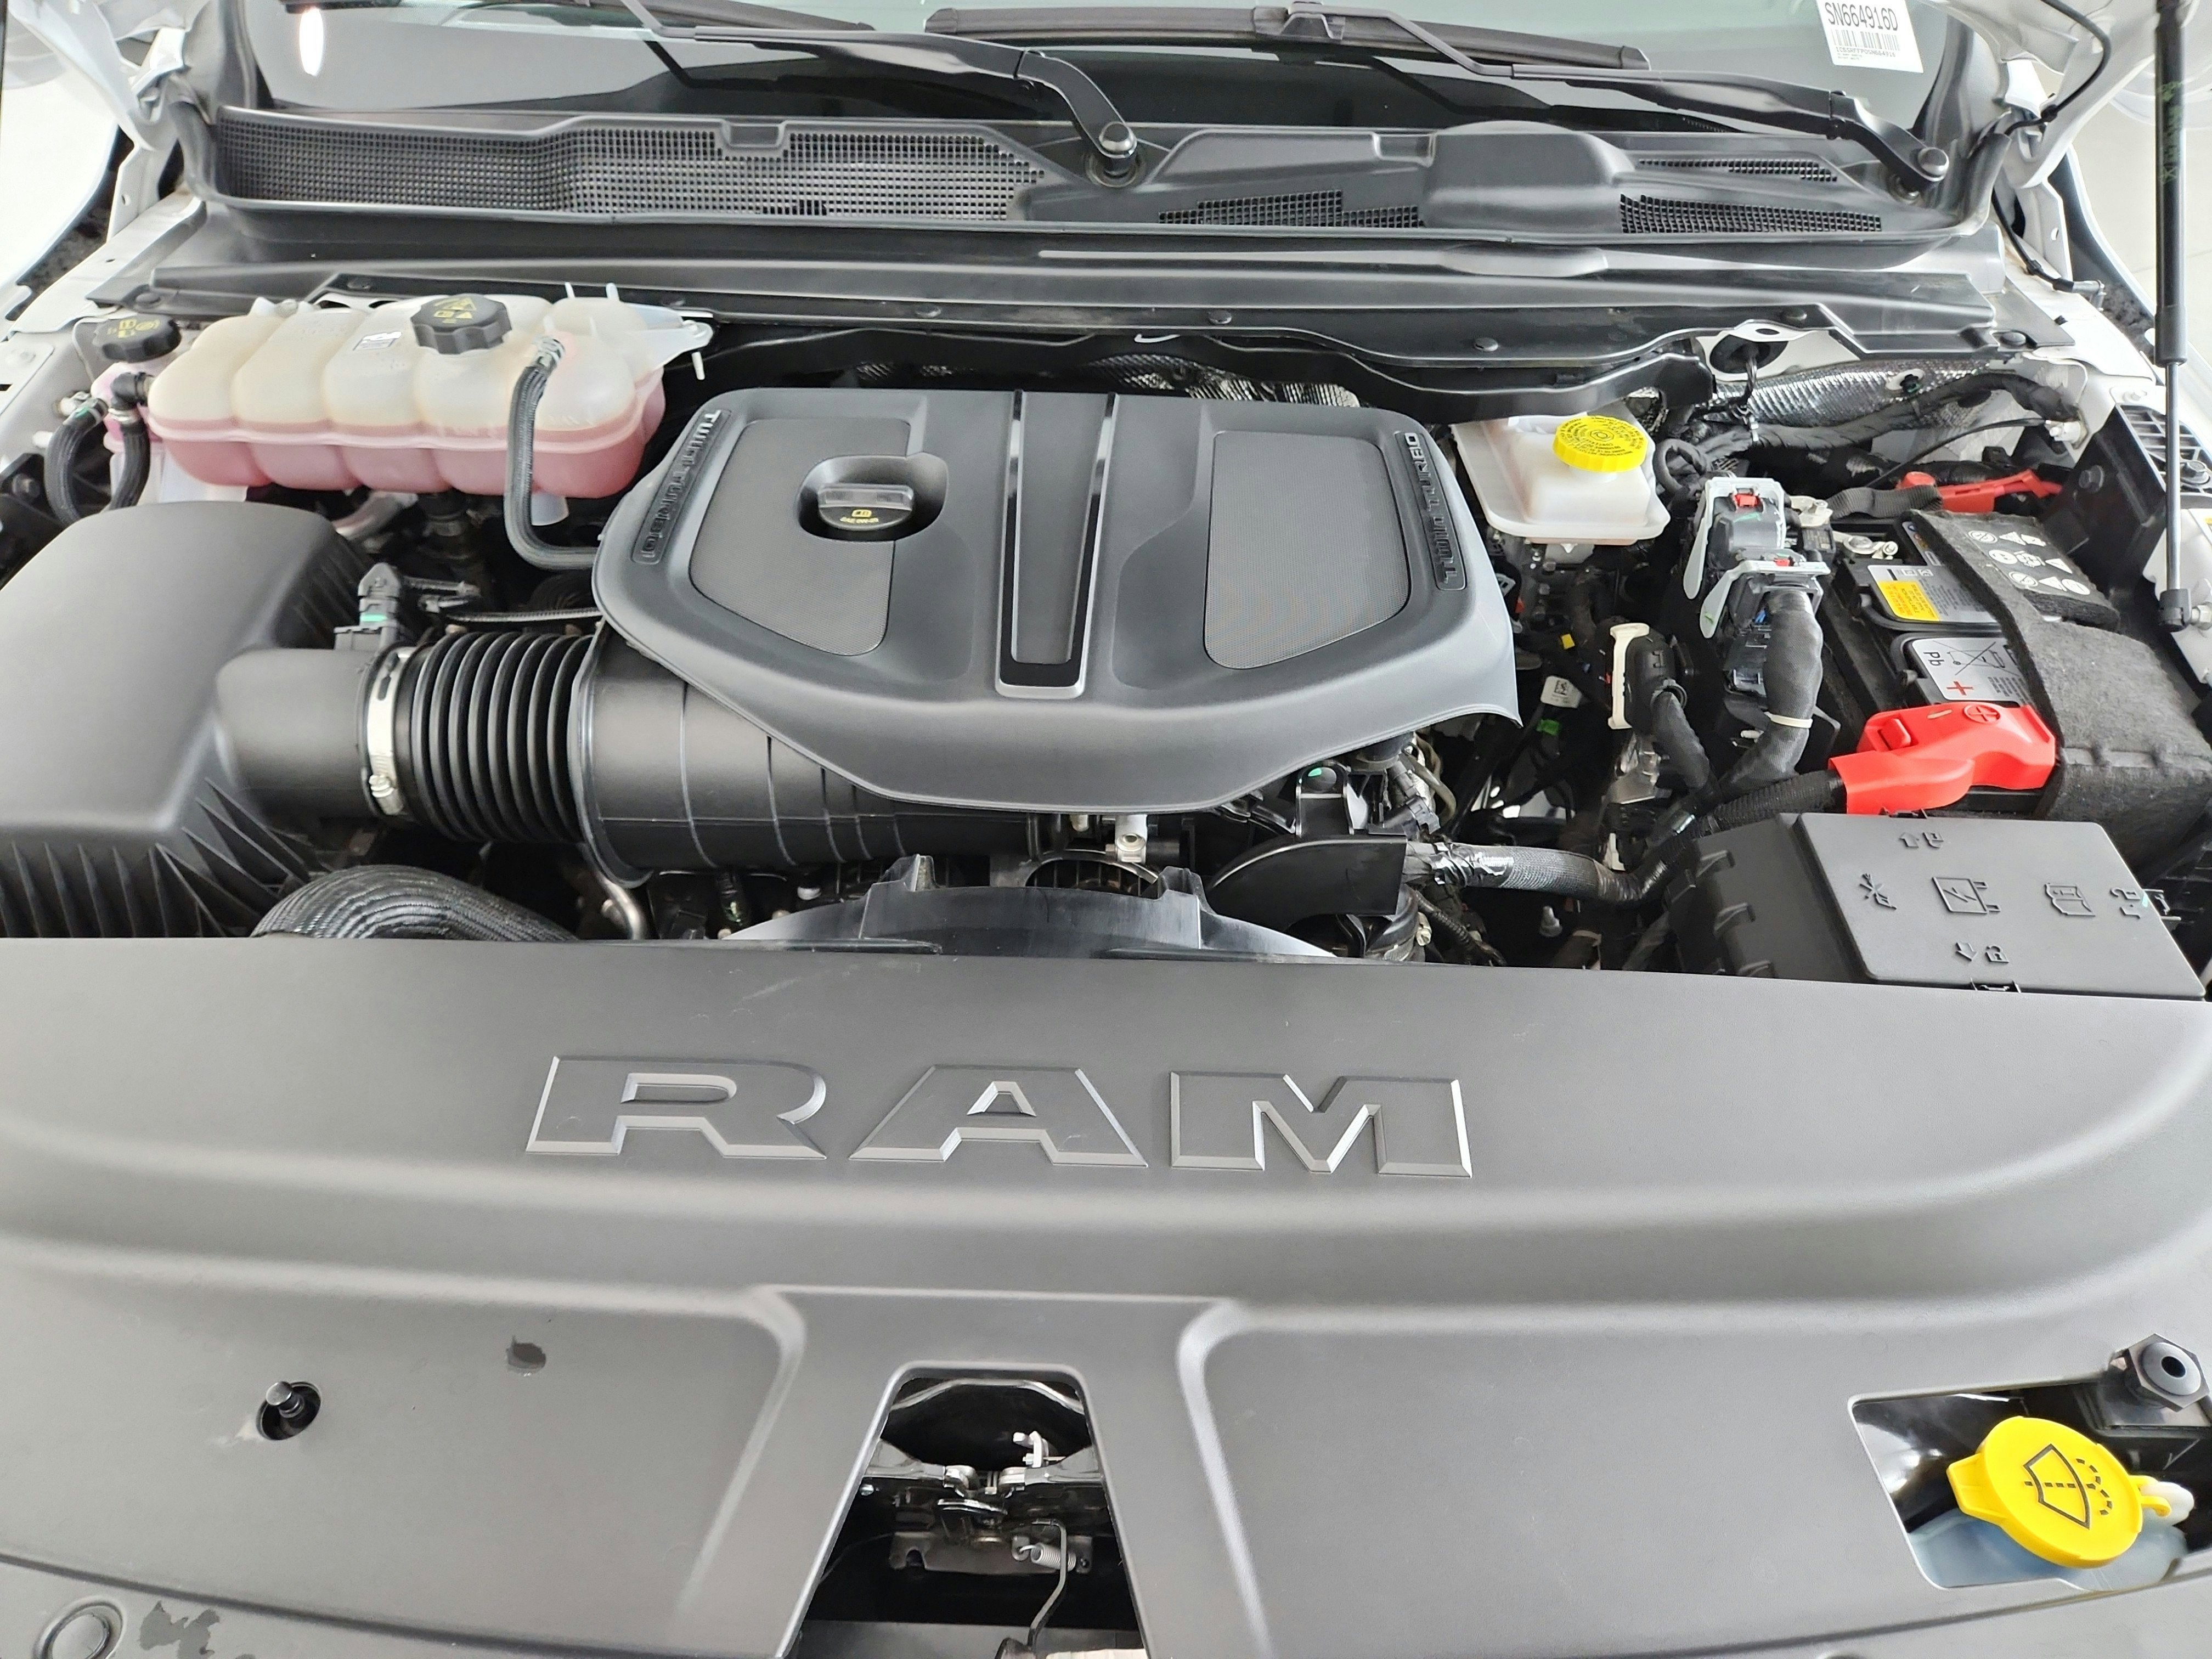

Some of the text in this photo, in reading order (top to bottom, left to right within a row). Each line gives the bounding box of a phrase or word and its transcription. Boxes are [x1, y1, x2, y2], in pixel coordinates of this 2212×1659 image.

[1825, 2, 1898, 31] SN664916D
[640, 409, 722, 558] TWIN TURBO
[1404, 432, 1458, 584] TWIN TURBO
[1923, 651, 1945, 667] Pb
[526, 1056, 1472, 1178] RAM
